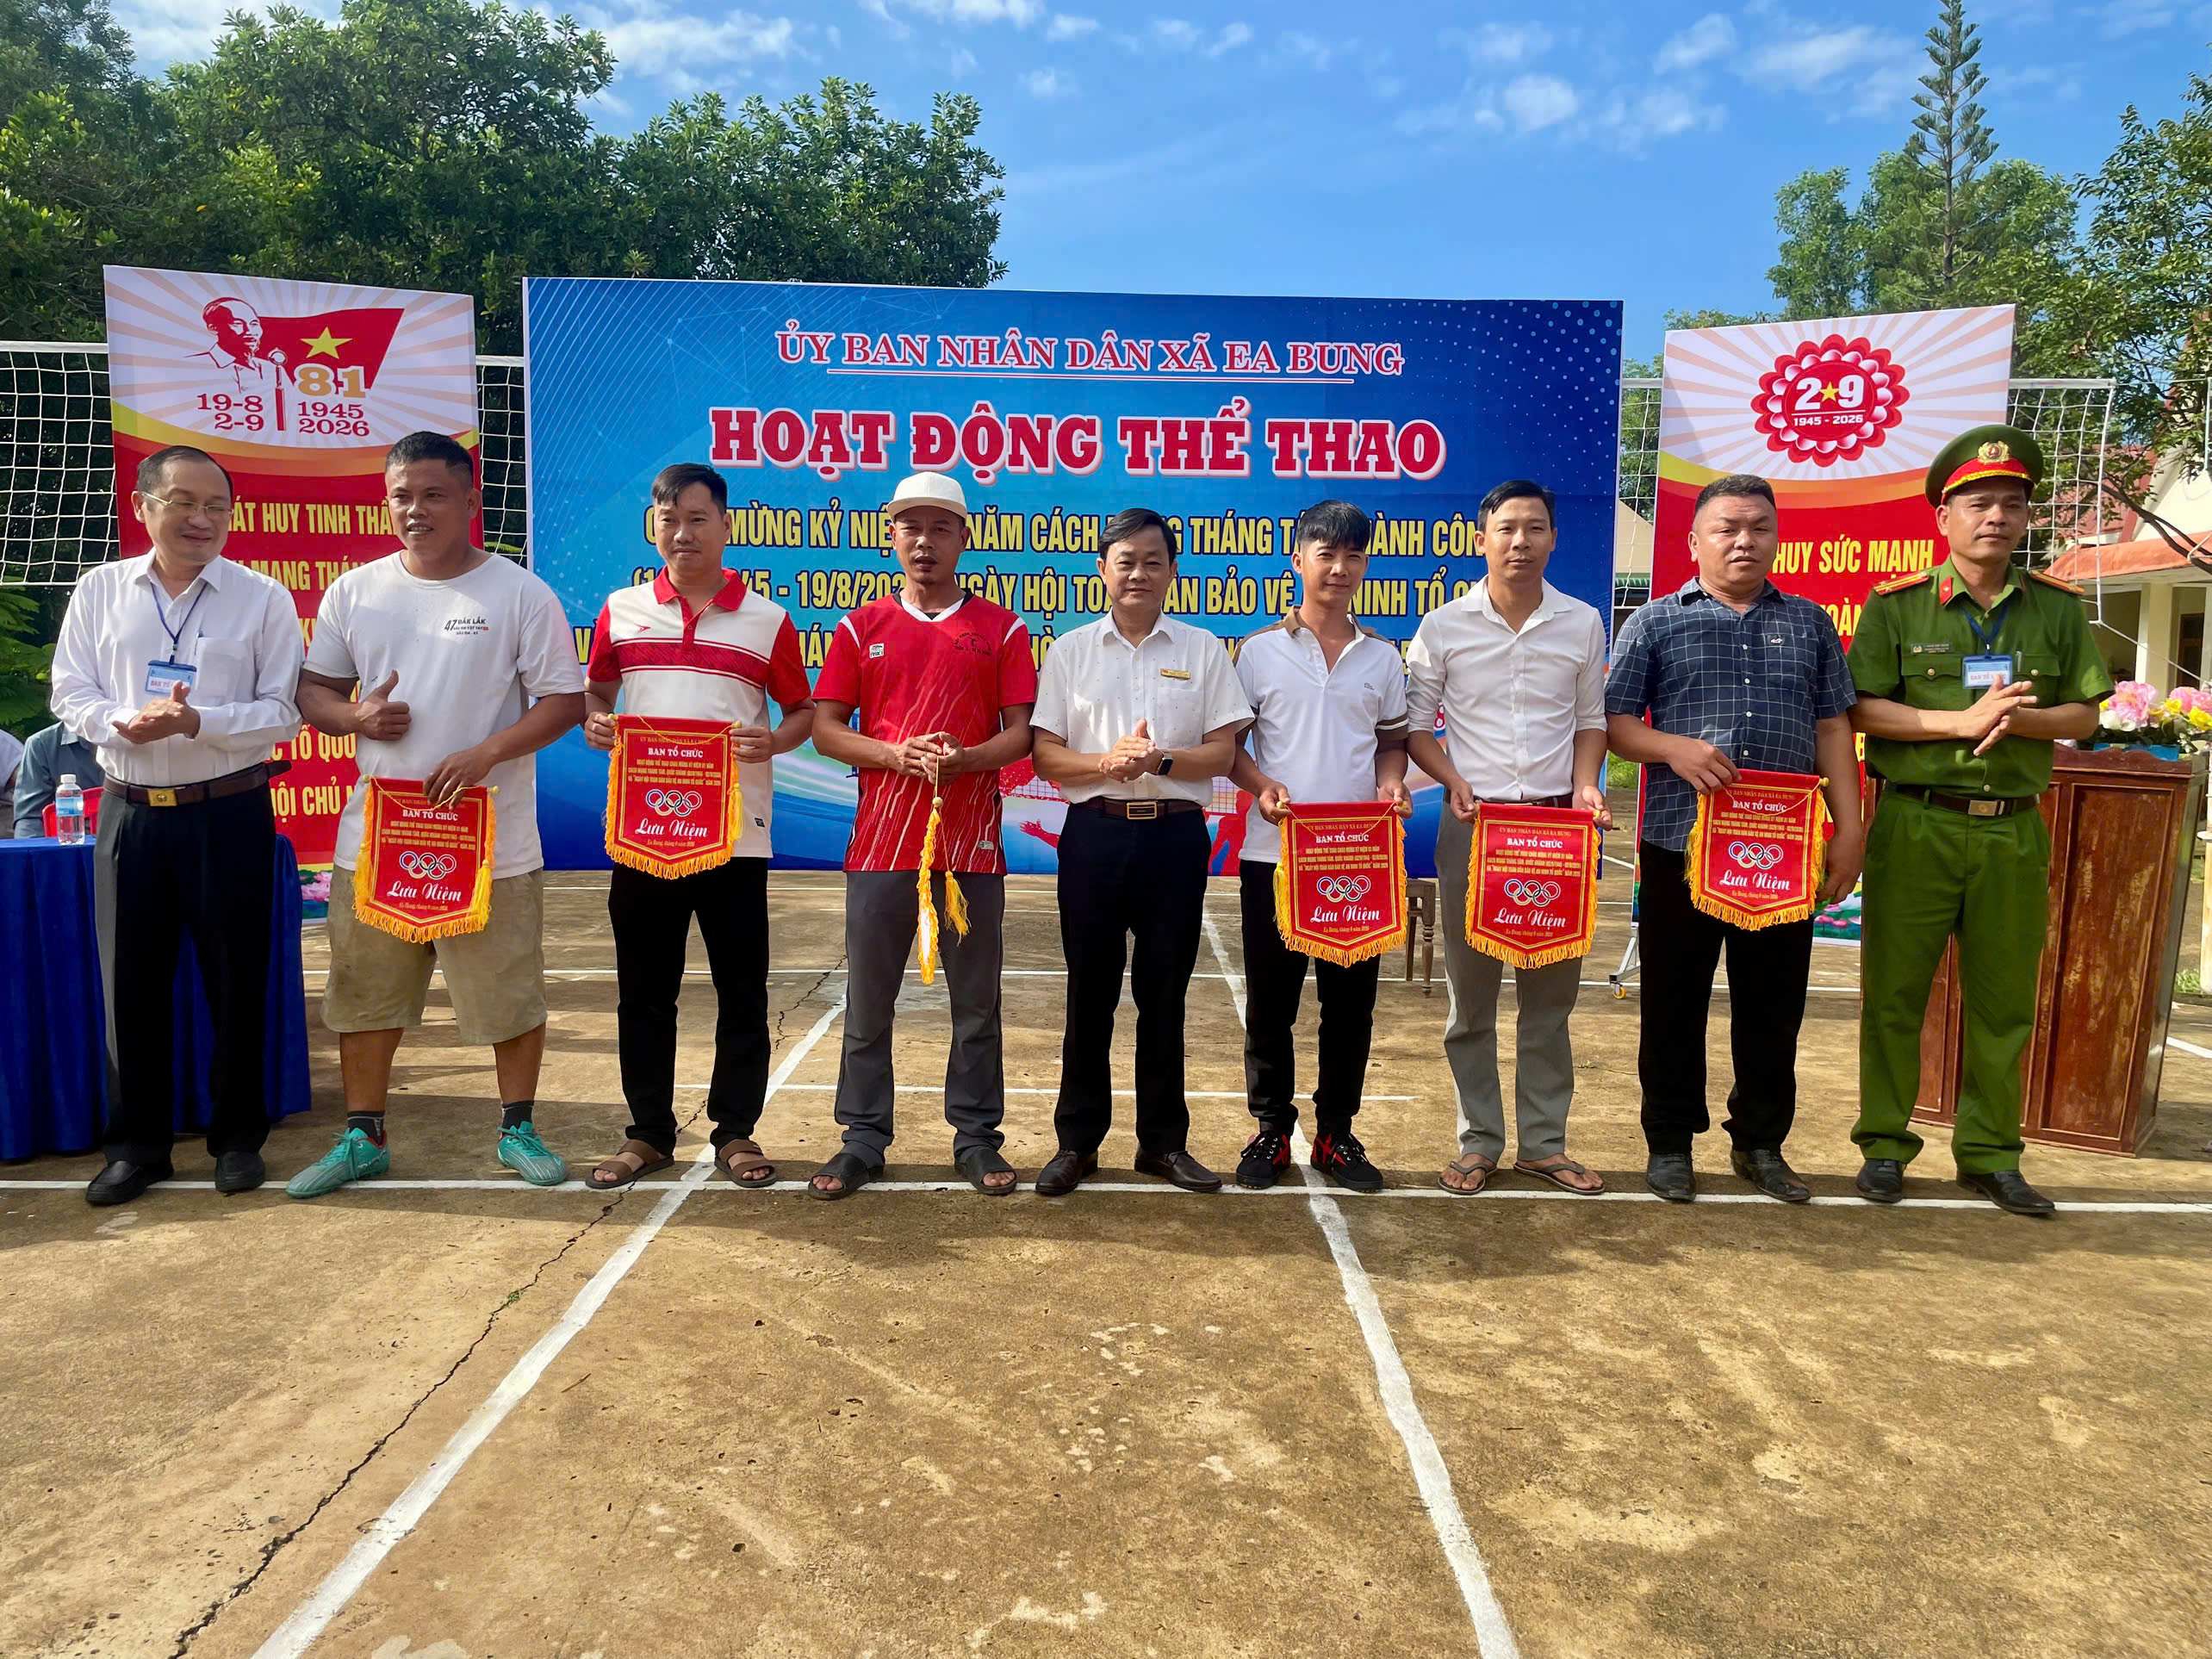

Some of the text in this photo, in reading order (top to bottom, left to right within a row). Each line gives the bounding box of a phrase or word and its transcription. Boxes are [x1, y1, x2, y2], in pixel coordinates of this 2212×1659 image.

[775, 319, 1406, 376] ỦY BAN NHÂN DÂN XÃ EA BUNG
[294, 363, 368, 400] 81
[197, 393, 264, 413] 19-8
[297, 401, 364, 419] 1945
[214, 413, 264, 432] 2-9
[298, 418, 370, 438] 2026
[1793, 416, 1823, 427] 1945
[1832, 414, 1864, 425] 2026
[709, 396, 1446, 485] HOẠT ĐỘNG THỂ THAO
[227, 495, 257, 532] ÁT
[261, 502, 301, 534] HUY
[305, 503, 351, 535] TINH
[725, 498, 893, 557] MỪNG KỶ NIỆ
[966, 506, 1100, 553] NĂM CÁCH
[1189, 509, 1274, 556] THÁNG
[1365, 512, 1484, 557] ÀNH CÔN
[1772, 533, 1935, 580] HUY SỨC MẠNH
[797, 571, 905, 609] 19/8/202
[1024, 568, 1065, 620] HỘI
[1206, 565, 1258, 614] BẢO
[1414, 565, 1447, 615] TỔ
[648, 747, 666, 756] BAN
[301, 774, 341, 817] CHỦ
[1732, 800, 1750, 809] BAN
[402, 810, 420, 818] BAN
[635, 817, 708, 840] Lưu Niệm
[1315, 835, 1333, 843] BAN
[1507, 837, 1525, 846] BAN
[387, 880, 463, 904] Lưu Niệm
[1719, 869, 1790, 893] Lưu Niệm
[1309, 904, 1381, 924] Lưu Niệm
[1493, 907, 1567, 930] Lưu Niệm
